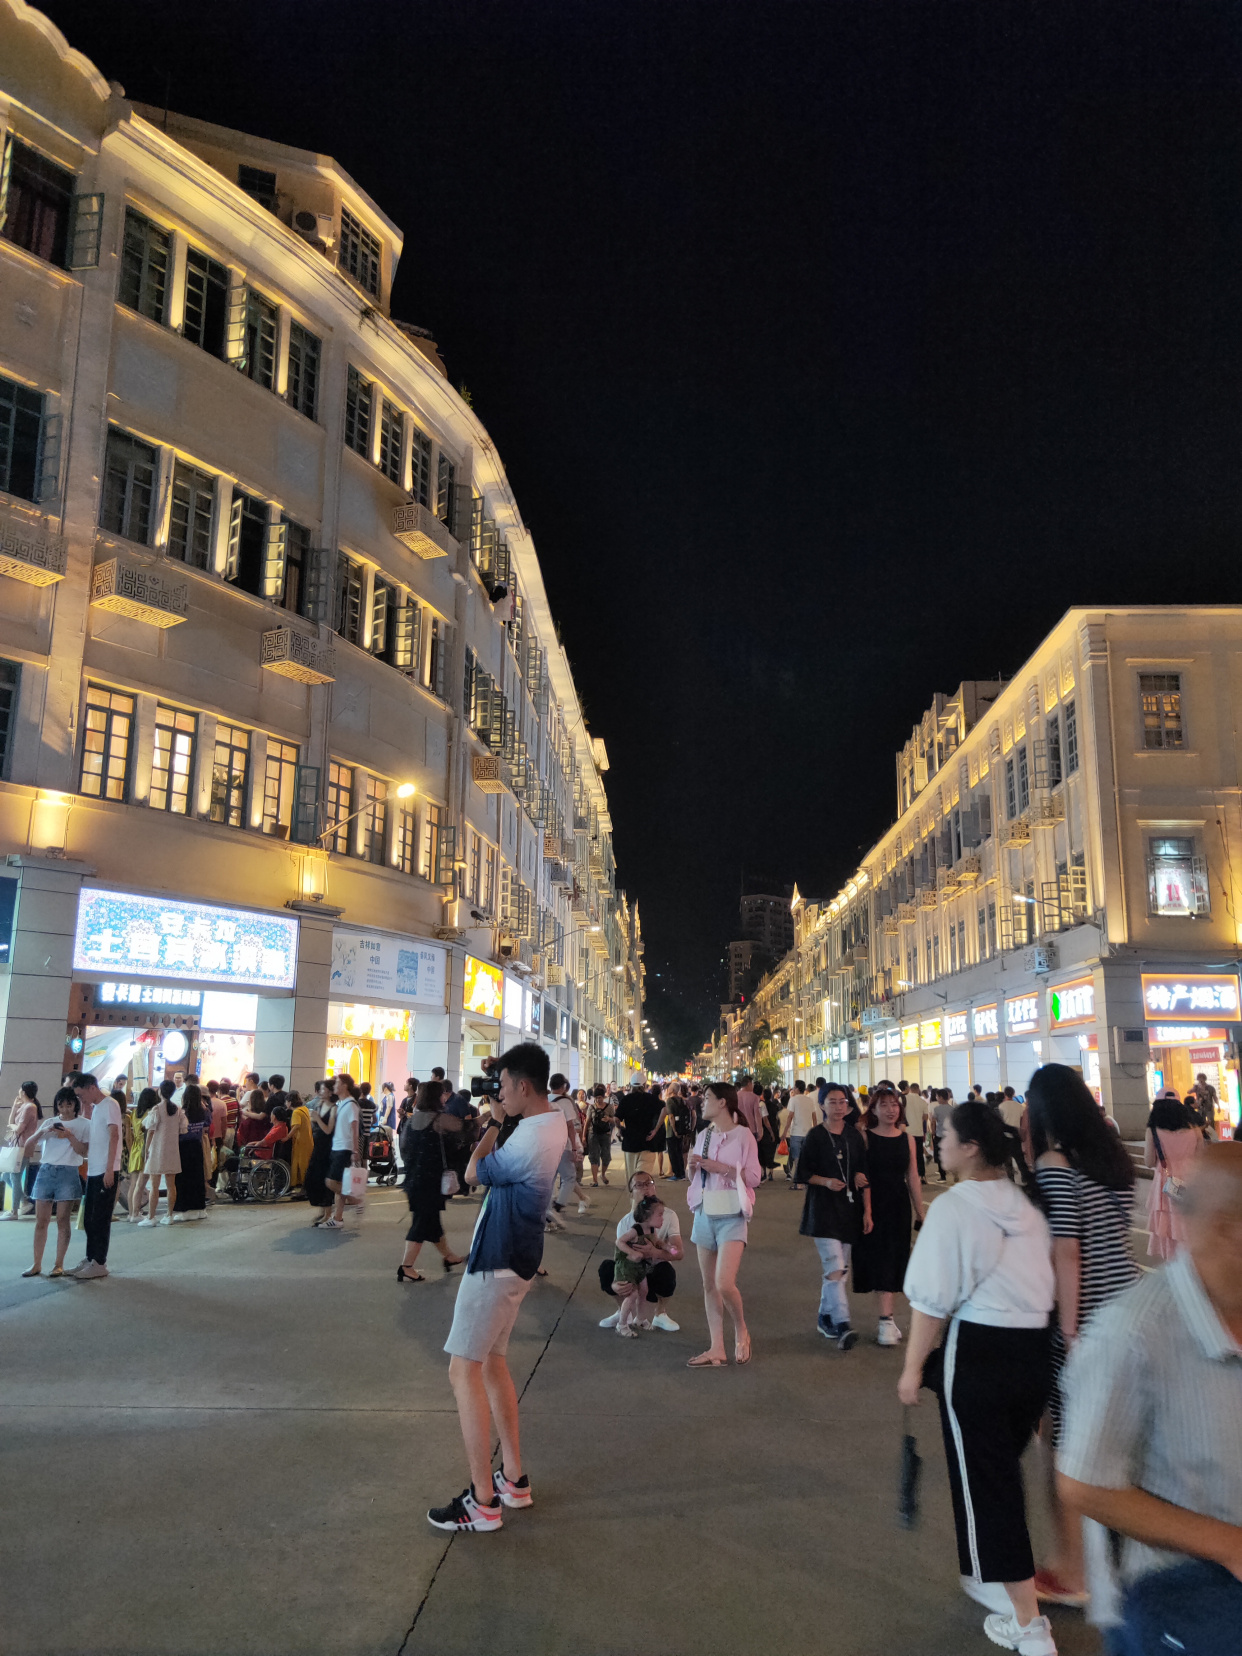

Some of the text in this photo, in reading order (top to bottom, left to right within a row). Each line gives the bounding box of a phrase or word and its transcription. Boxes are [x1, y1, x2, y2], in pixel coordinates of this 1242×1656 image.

[359, 939, 381, 951] 吉祥如意
[369, 955, 381, 965] 中国
[1146, 984, 1237, 1010] 特产烟酒
